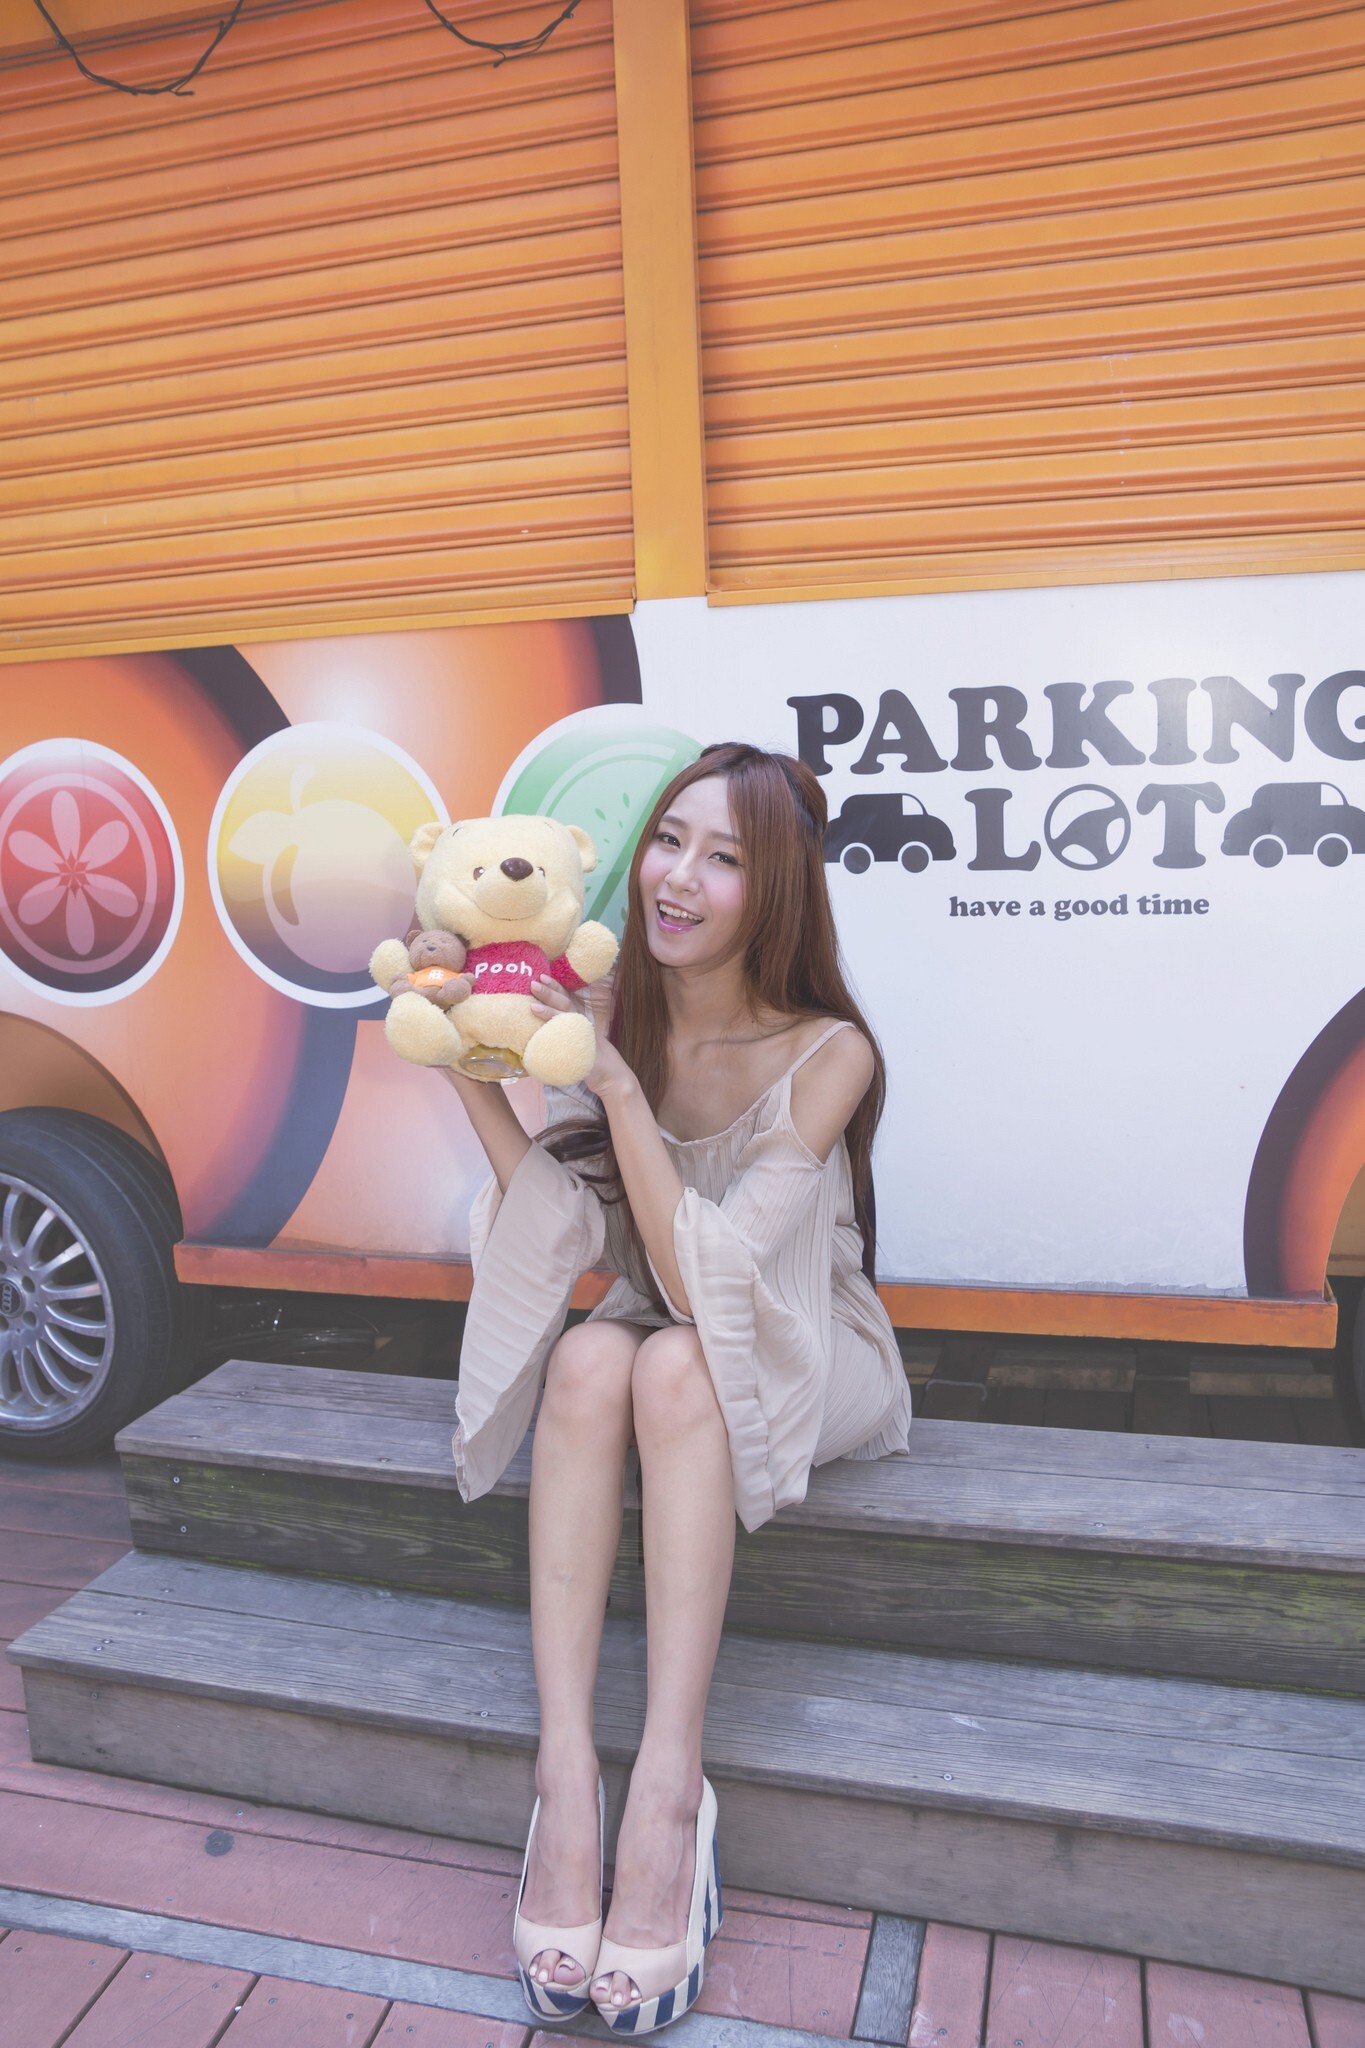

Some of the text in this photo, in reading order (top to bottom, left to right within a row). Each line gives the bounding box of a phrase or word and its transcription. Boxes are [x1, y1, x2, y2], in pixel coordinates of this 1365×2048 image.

[787, 670, 1365, 777] PARKING
[949, 894, 1209, 921] have a good time
[475, 961, 533, 979] pooh
